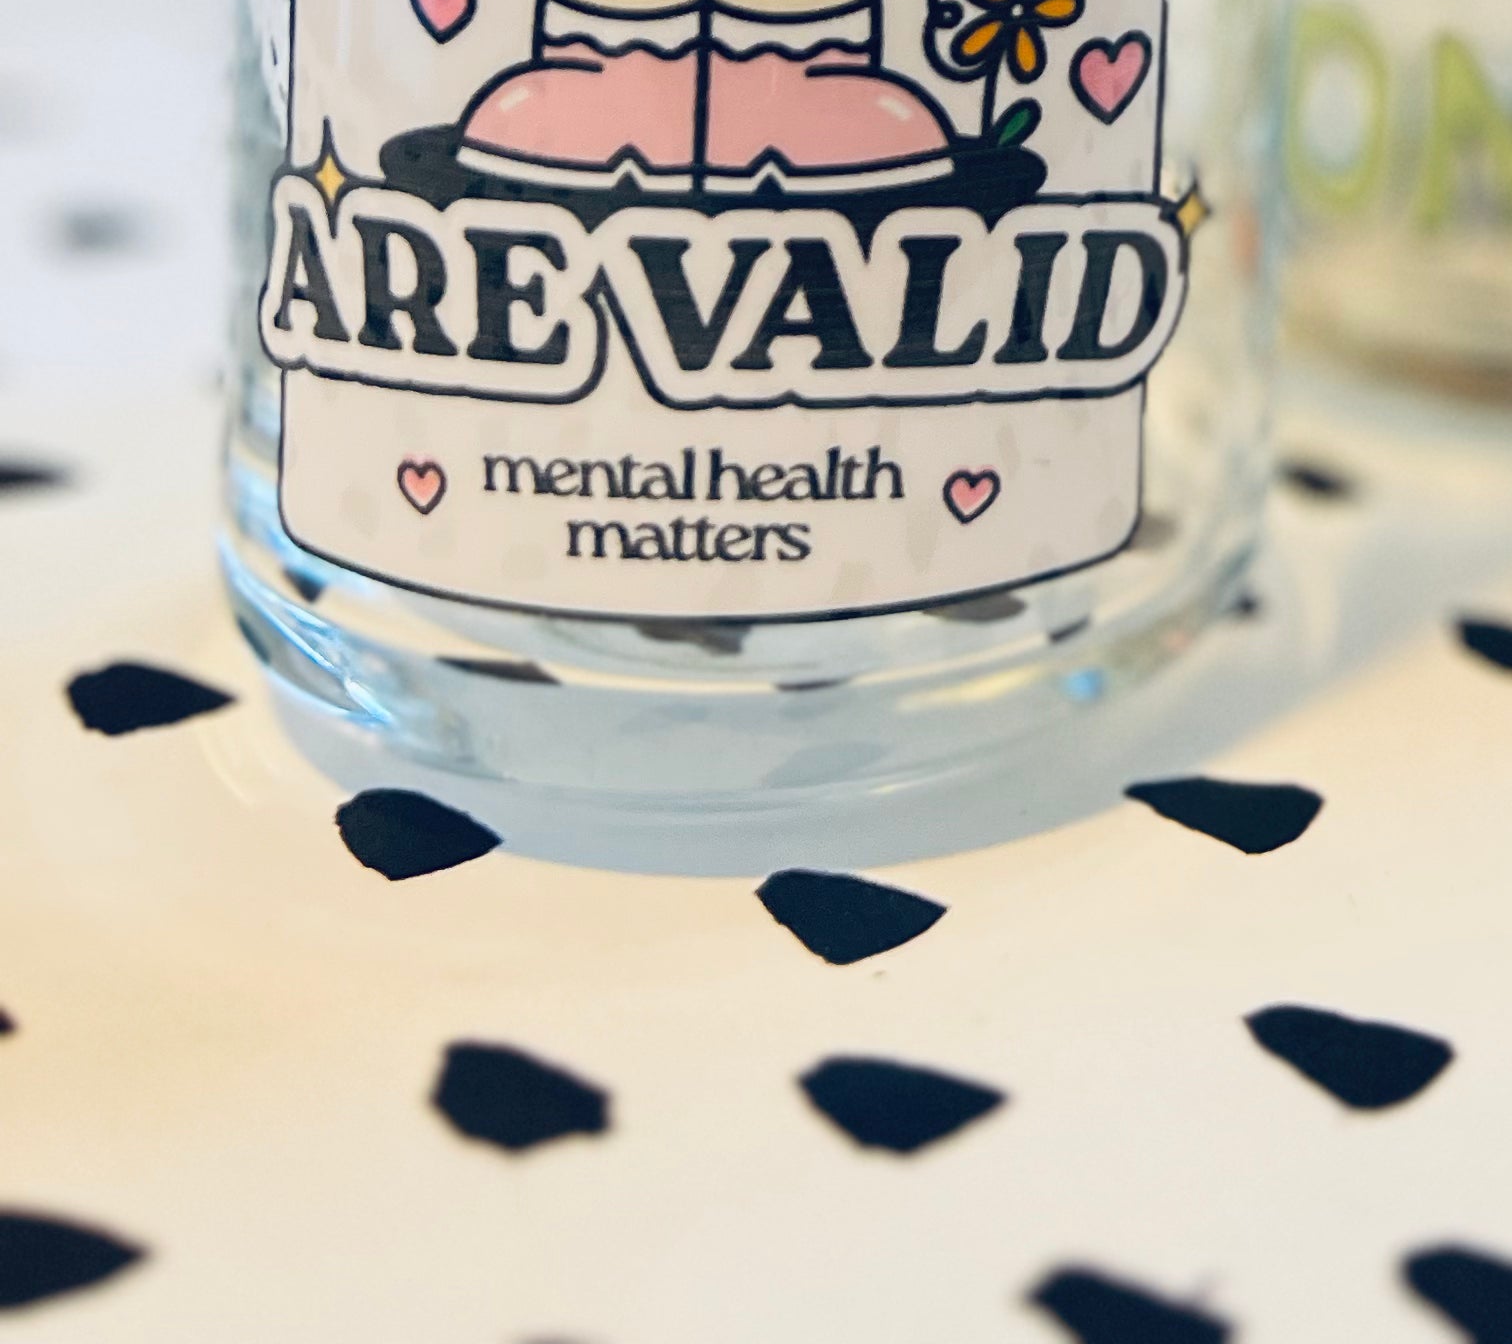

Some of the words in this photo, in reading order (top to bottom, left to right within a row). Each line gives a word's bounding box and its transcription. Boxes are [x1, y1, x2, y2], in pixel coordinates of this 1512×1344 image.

[272, 202, 570, 366] ARE
[628, 230, 1169, 373] VALID
[481, 446, 696, 502] mental
[706, 446, 905, 501] health
[565, 517, 812, 562] matters
